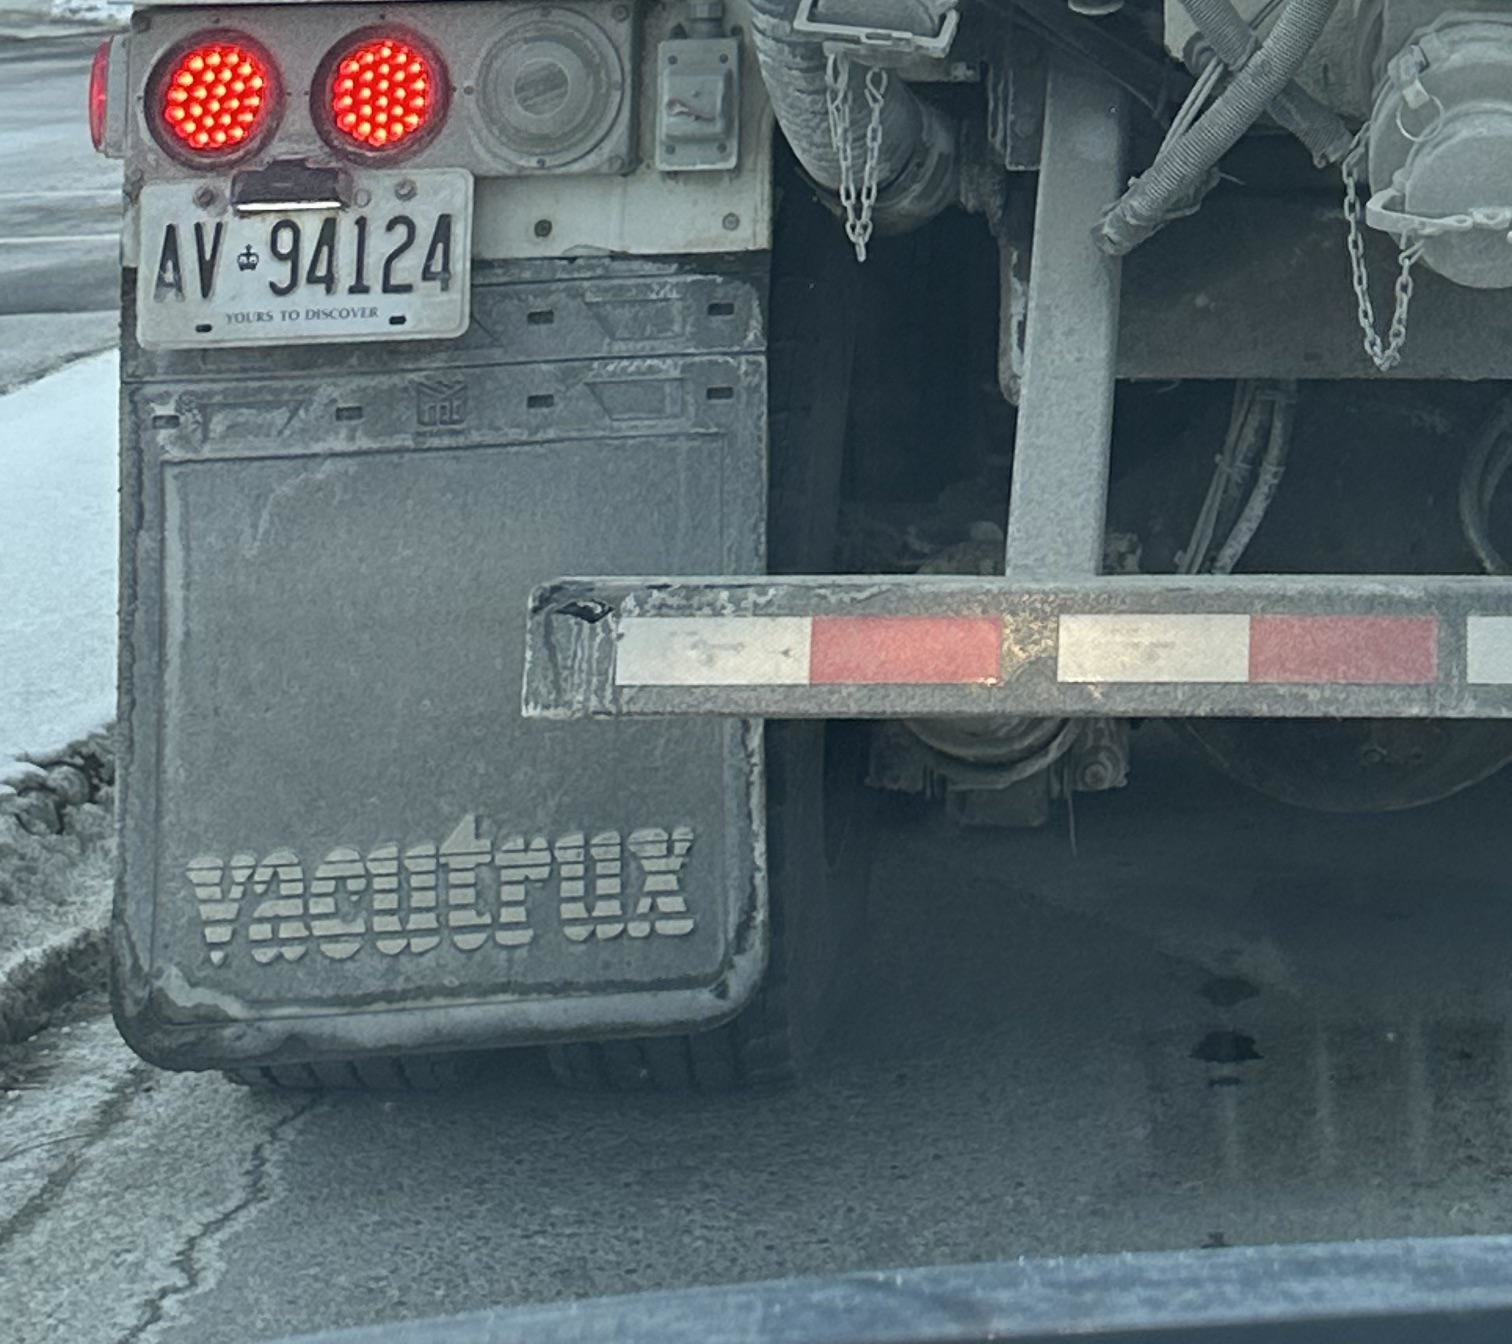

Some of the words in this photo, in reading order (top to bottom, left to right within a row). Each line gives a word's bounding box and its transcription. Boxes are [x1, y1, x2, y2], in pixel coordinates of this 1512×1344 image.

[153, 222, 224, 303] AV
[269, 213, 453, 297] 94124
[225, 312, 274, 325] YOURS
[281, 309, 300, 322] TO
[304, 306, 380, 322] DISCOVER
